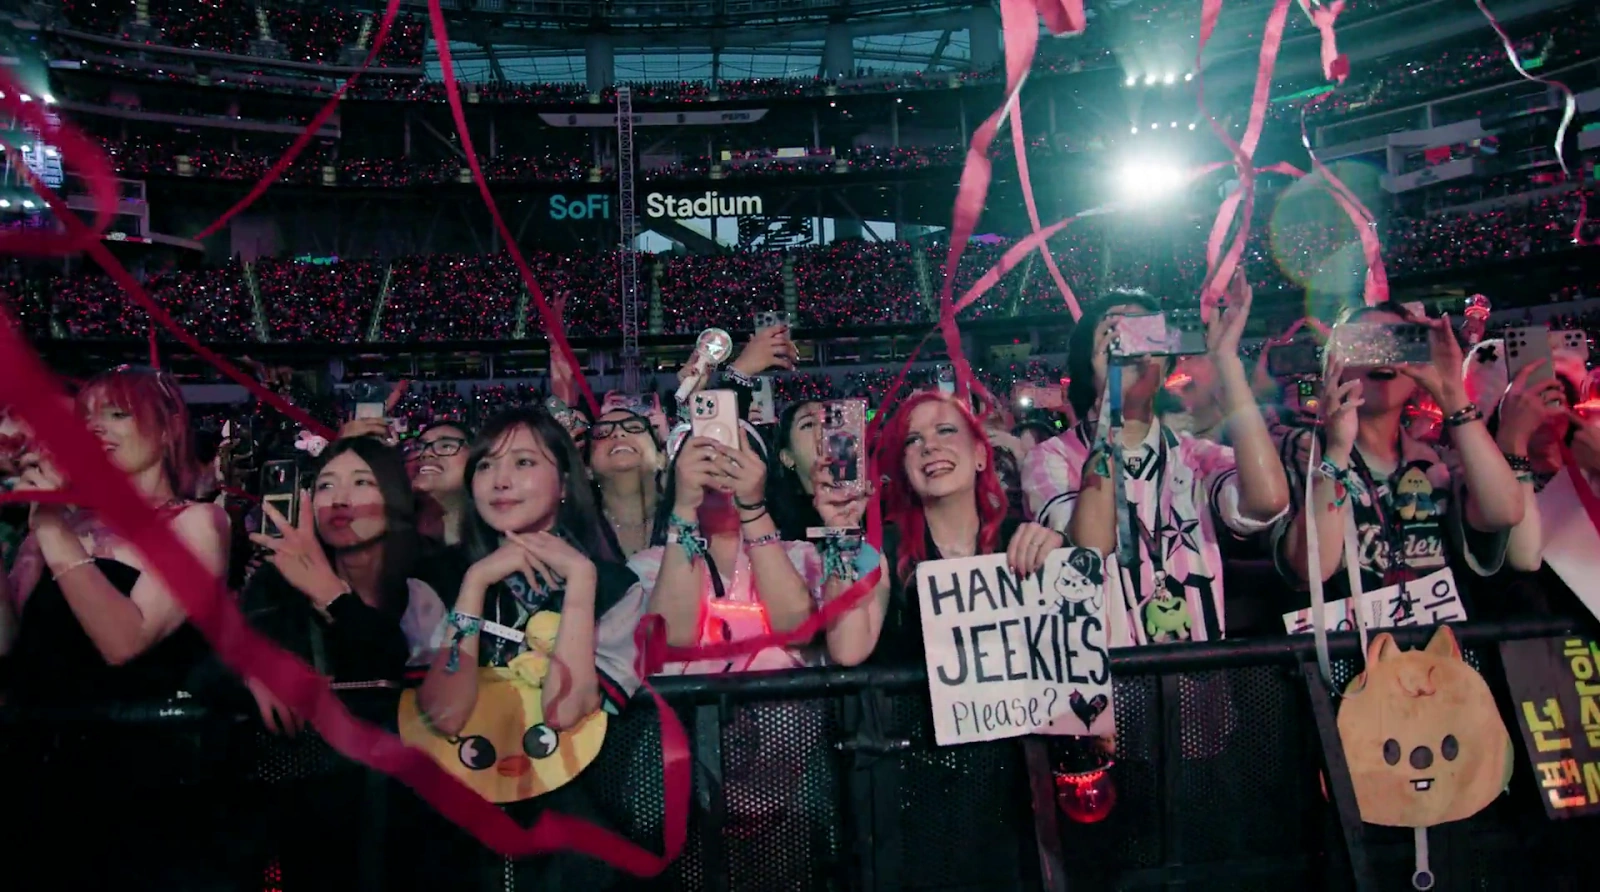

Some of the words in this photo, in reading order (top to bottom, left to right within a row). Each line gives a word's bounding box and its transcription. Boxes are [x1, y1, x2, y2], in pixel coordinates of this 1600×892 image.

[549, 194, 609, 220] SoFi
[646, 191, 763, 218] Stadium
[928, 565, 1046, 616] HAN!
[936, 614, 1110, 686] JEEKIES
[952, 687, 1058, 736] Please?
